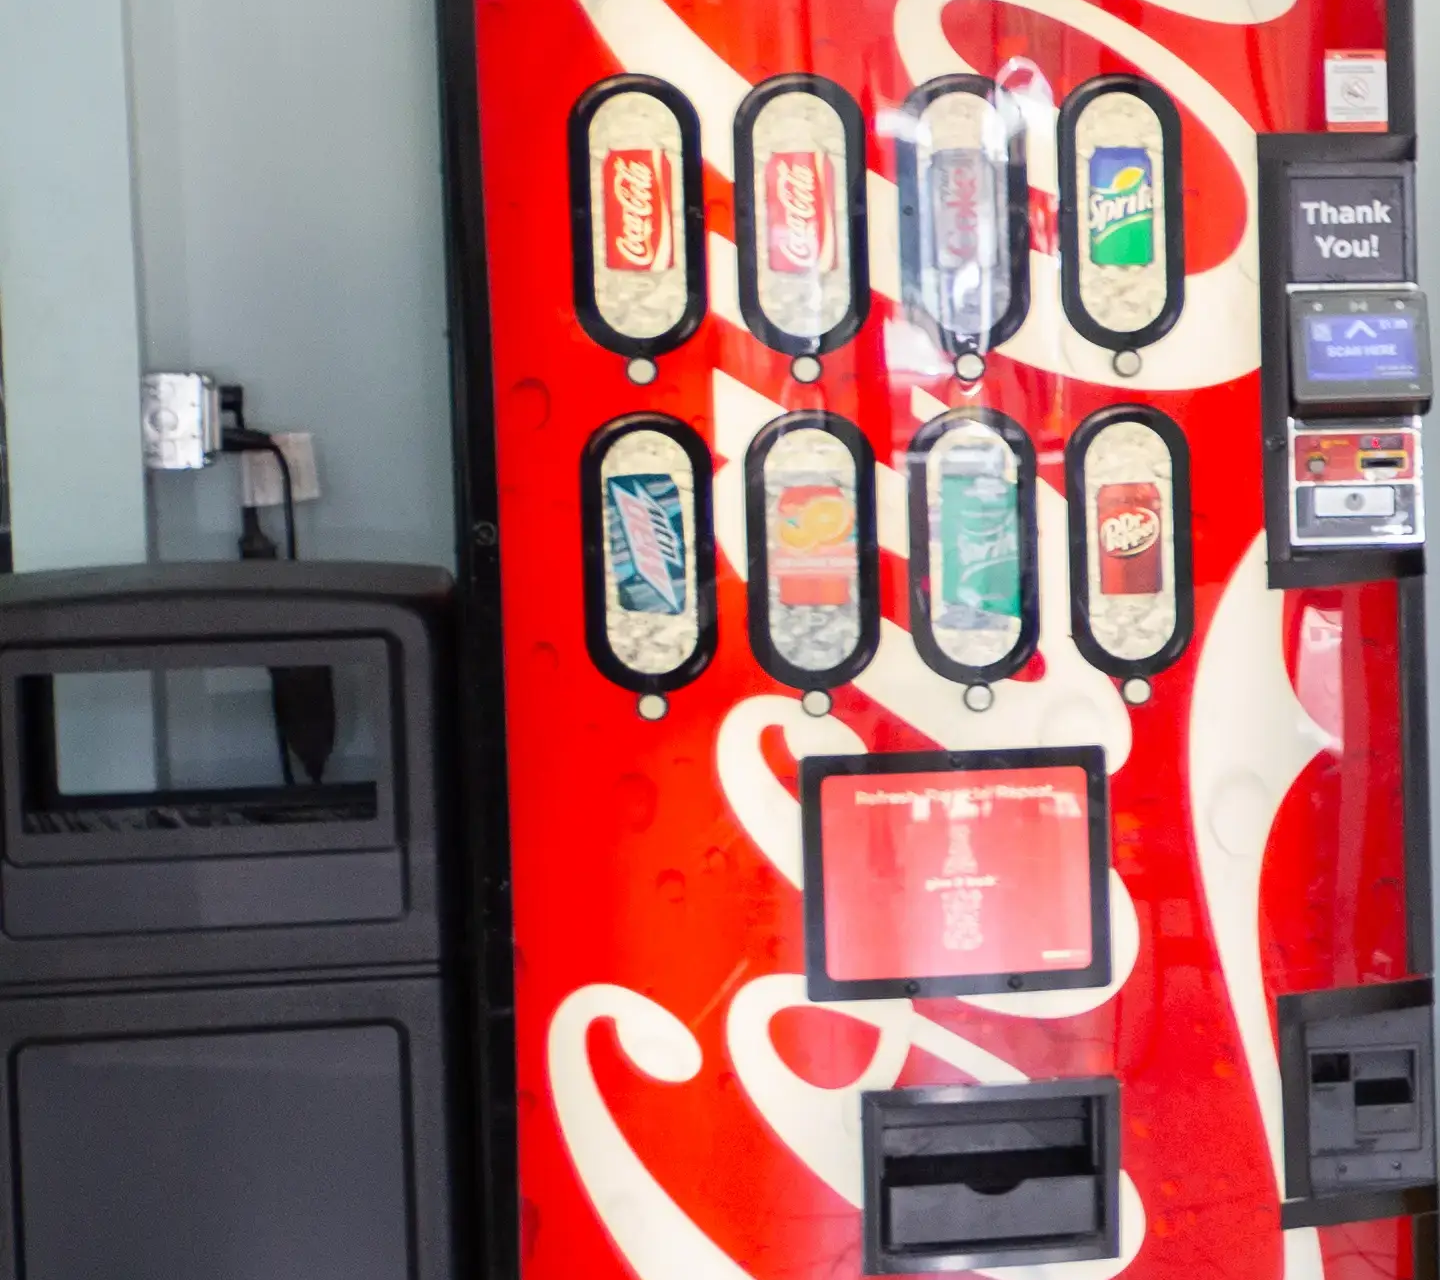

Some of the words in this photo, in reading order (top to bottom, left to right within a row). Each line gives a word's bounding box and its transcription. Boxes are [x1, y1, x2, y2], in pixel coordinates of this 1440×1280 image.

[613, 156, 655, 267] Coca-Cola
[776, 160, 818, 268] Coca-Cola
[1300, 200, 1393, 226] Thank
[1314, 234, 1381, 260] You!
